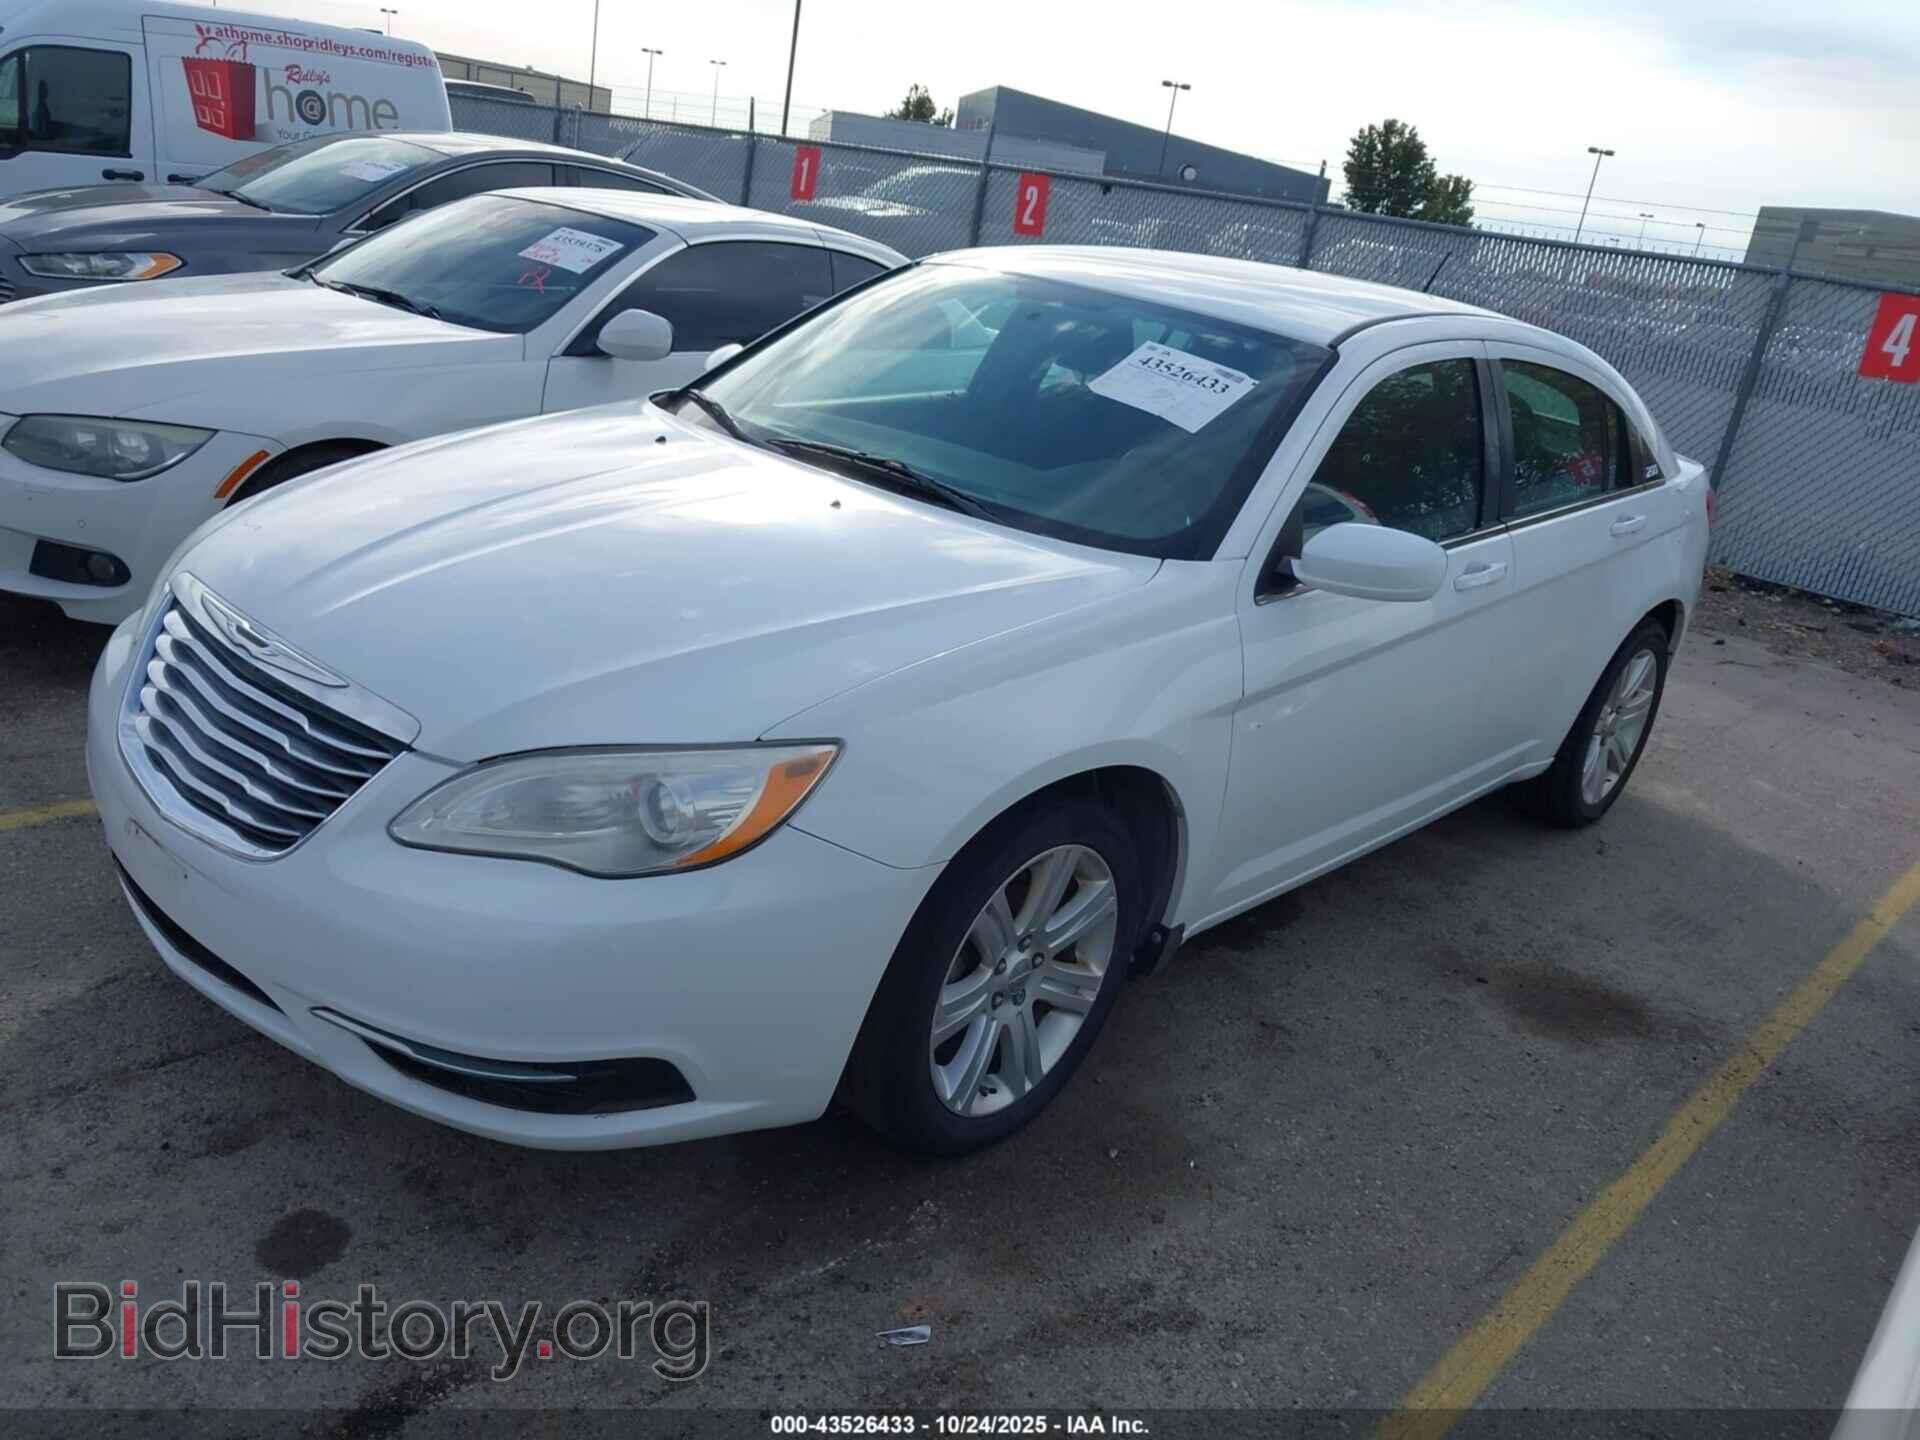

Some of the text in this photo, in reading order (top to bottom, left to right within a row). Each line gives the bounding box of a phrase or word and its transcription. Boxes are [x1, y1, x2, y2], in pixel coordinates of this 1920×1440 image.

[800, 157, 810, 192] 1
[1022, 186, 1039, 226] 2
[1881, 313, 1918, 367] 4
[1139, 356, 1230, 394] 43526433
